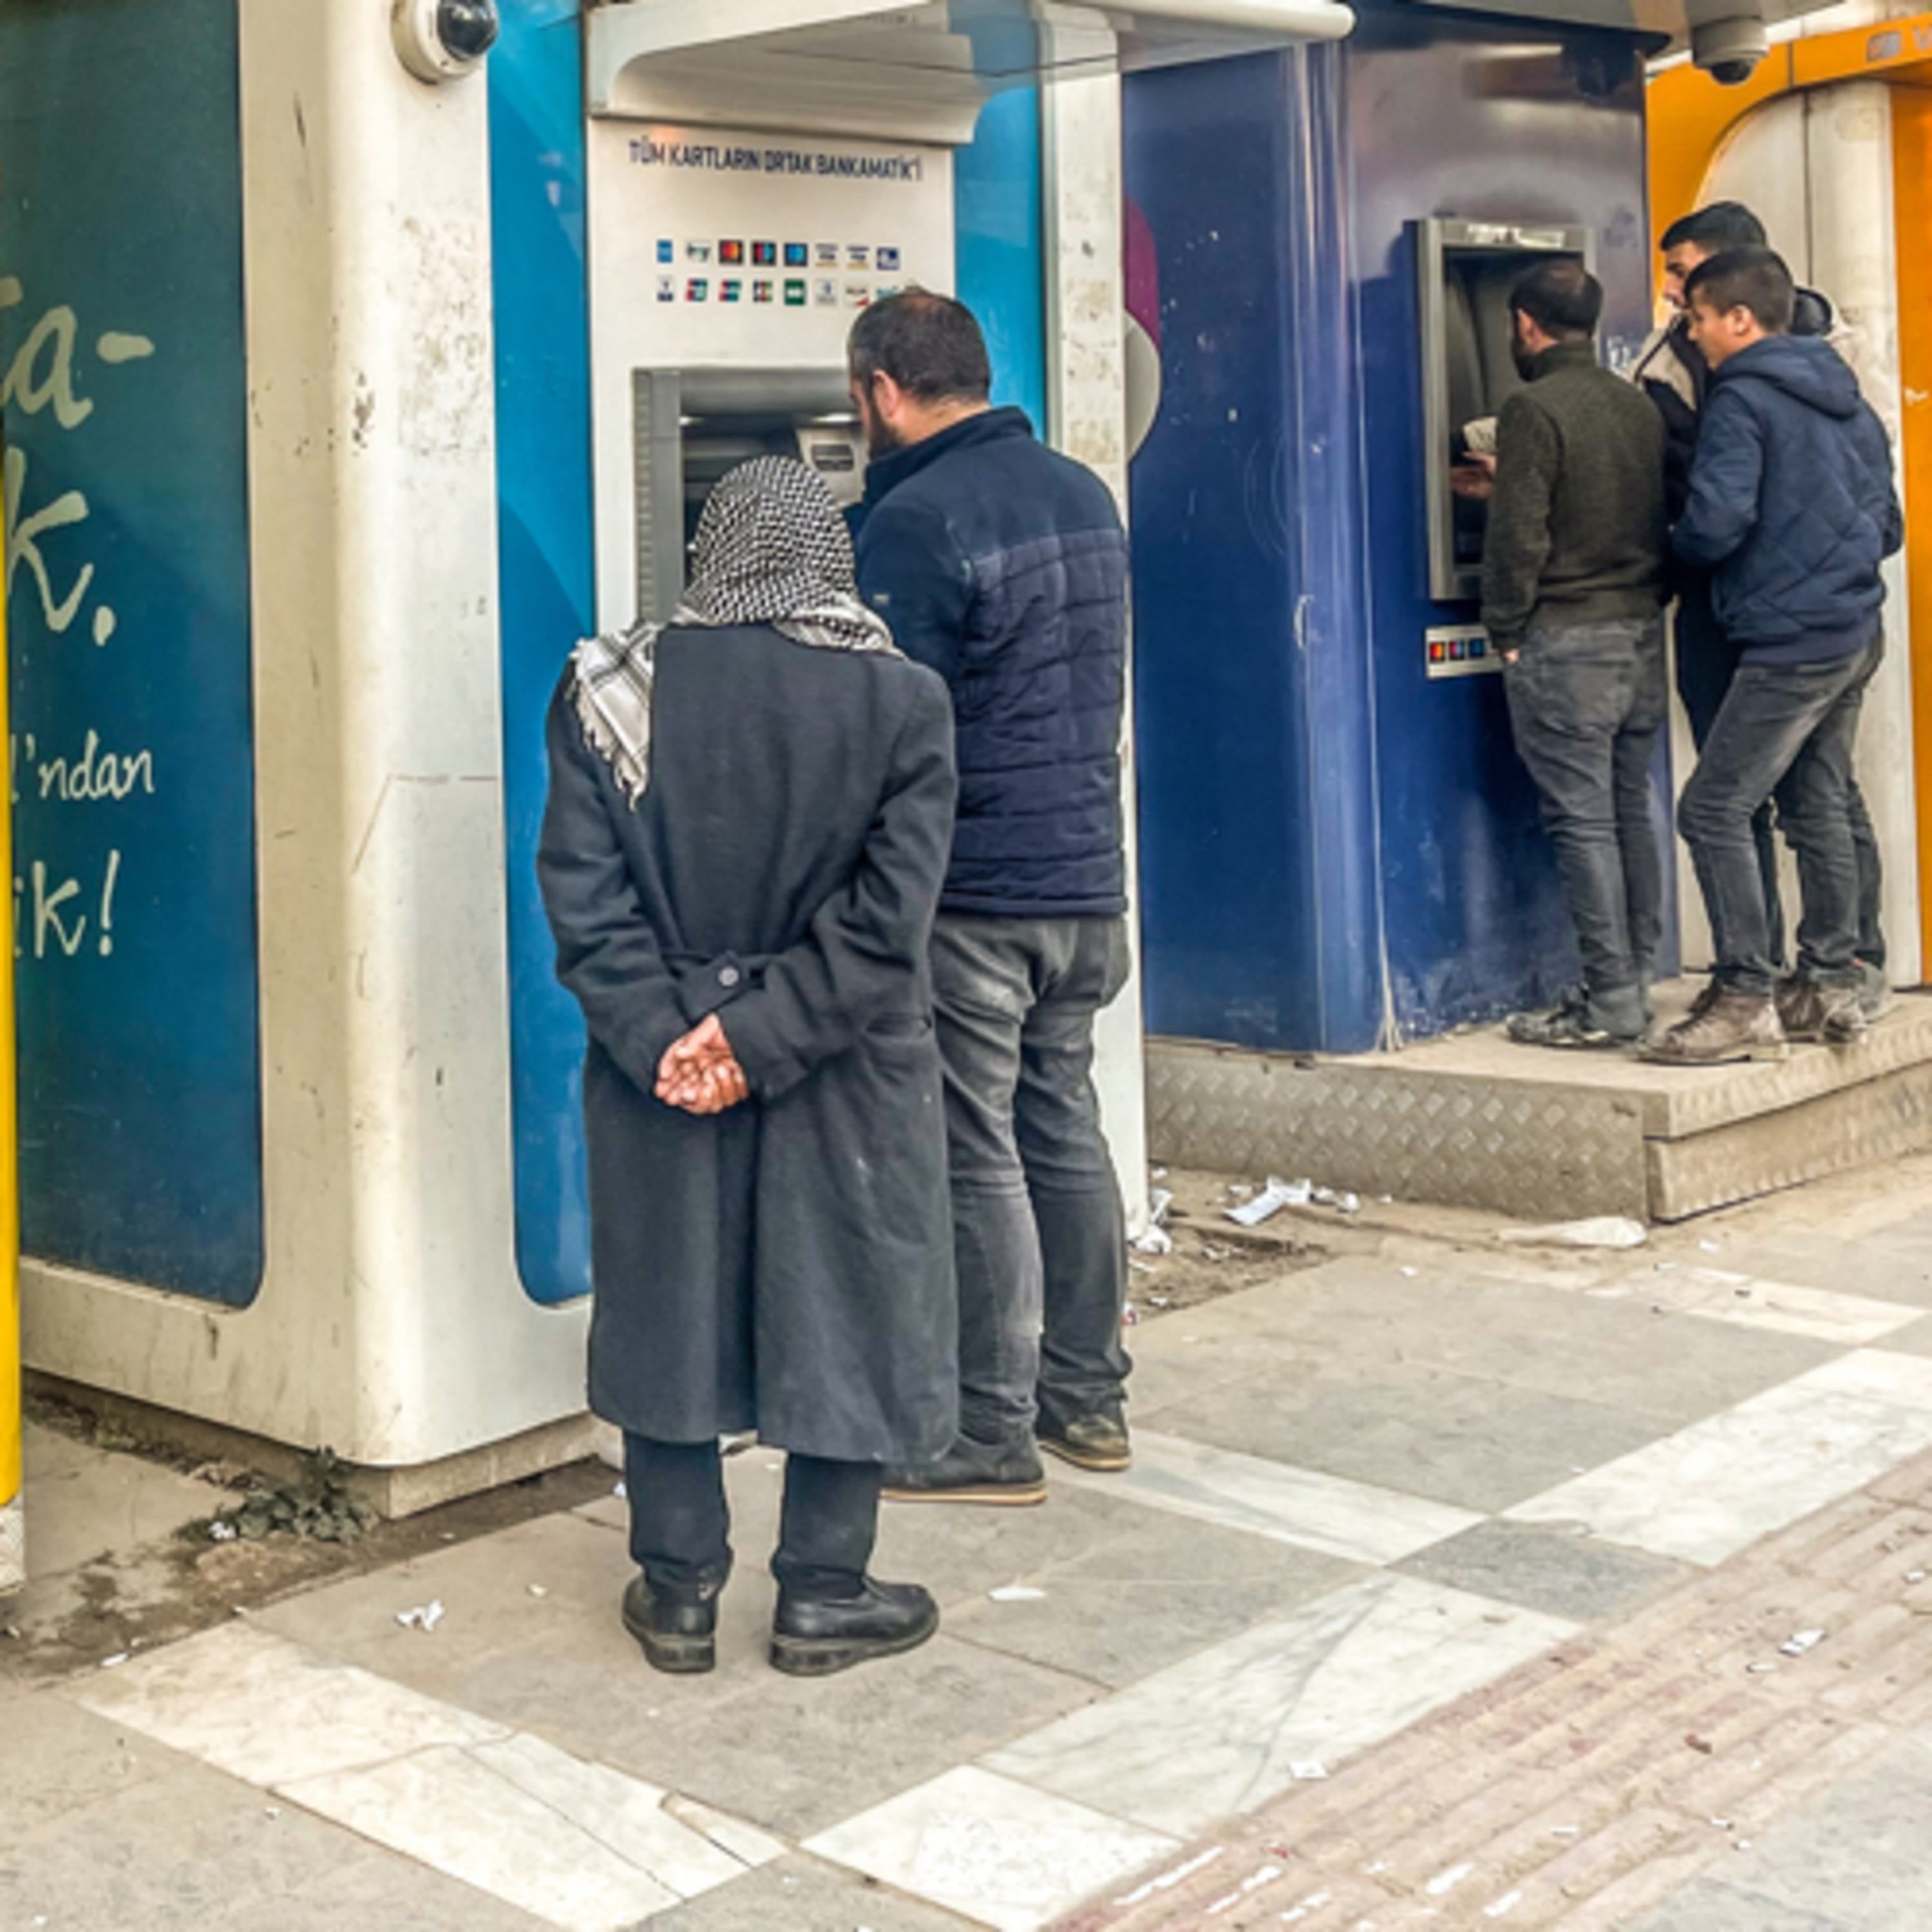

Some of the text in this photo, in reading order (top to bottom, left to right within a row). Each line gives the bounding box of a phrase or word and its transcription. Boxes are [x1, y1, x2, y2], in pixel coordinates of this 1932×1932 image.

[629, 136, 665, 166] TÜM
[668, 143, 761, 172] KARTLARIN
[764, 150, 815, 175] ORTAK
[0, 276, 155, 429] a-
